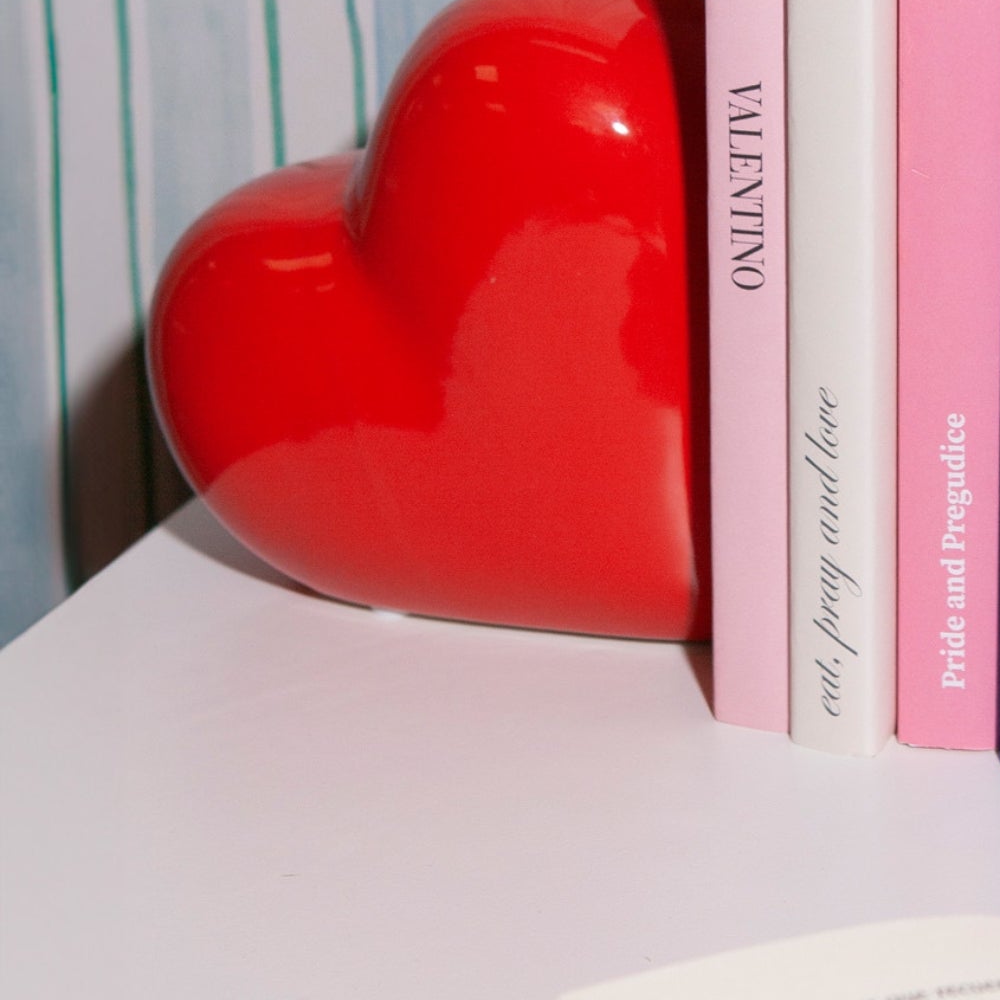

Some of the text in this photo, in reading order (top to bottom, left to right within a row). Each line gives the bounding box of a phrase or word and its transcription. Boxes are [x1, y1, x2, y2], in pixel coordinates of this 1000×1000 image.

[728, 80, 765, 291] VALENTINO
[804, 385, 862, 718] eat, pray and love
[940, 413, 974, 689] Pride and Pregudice
